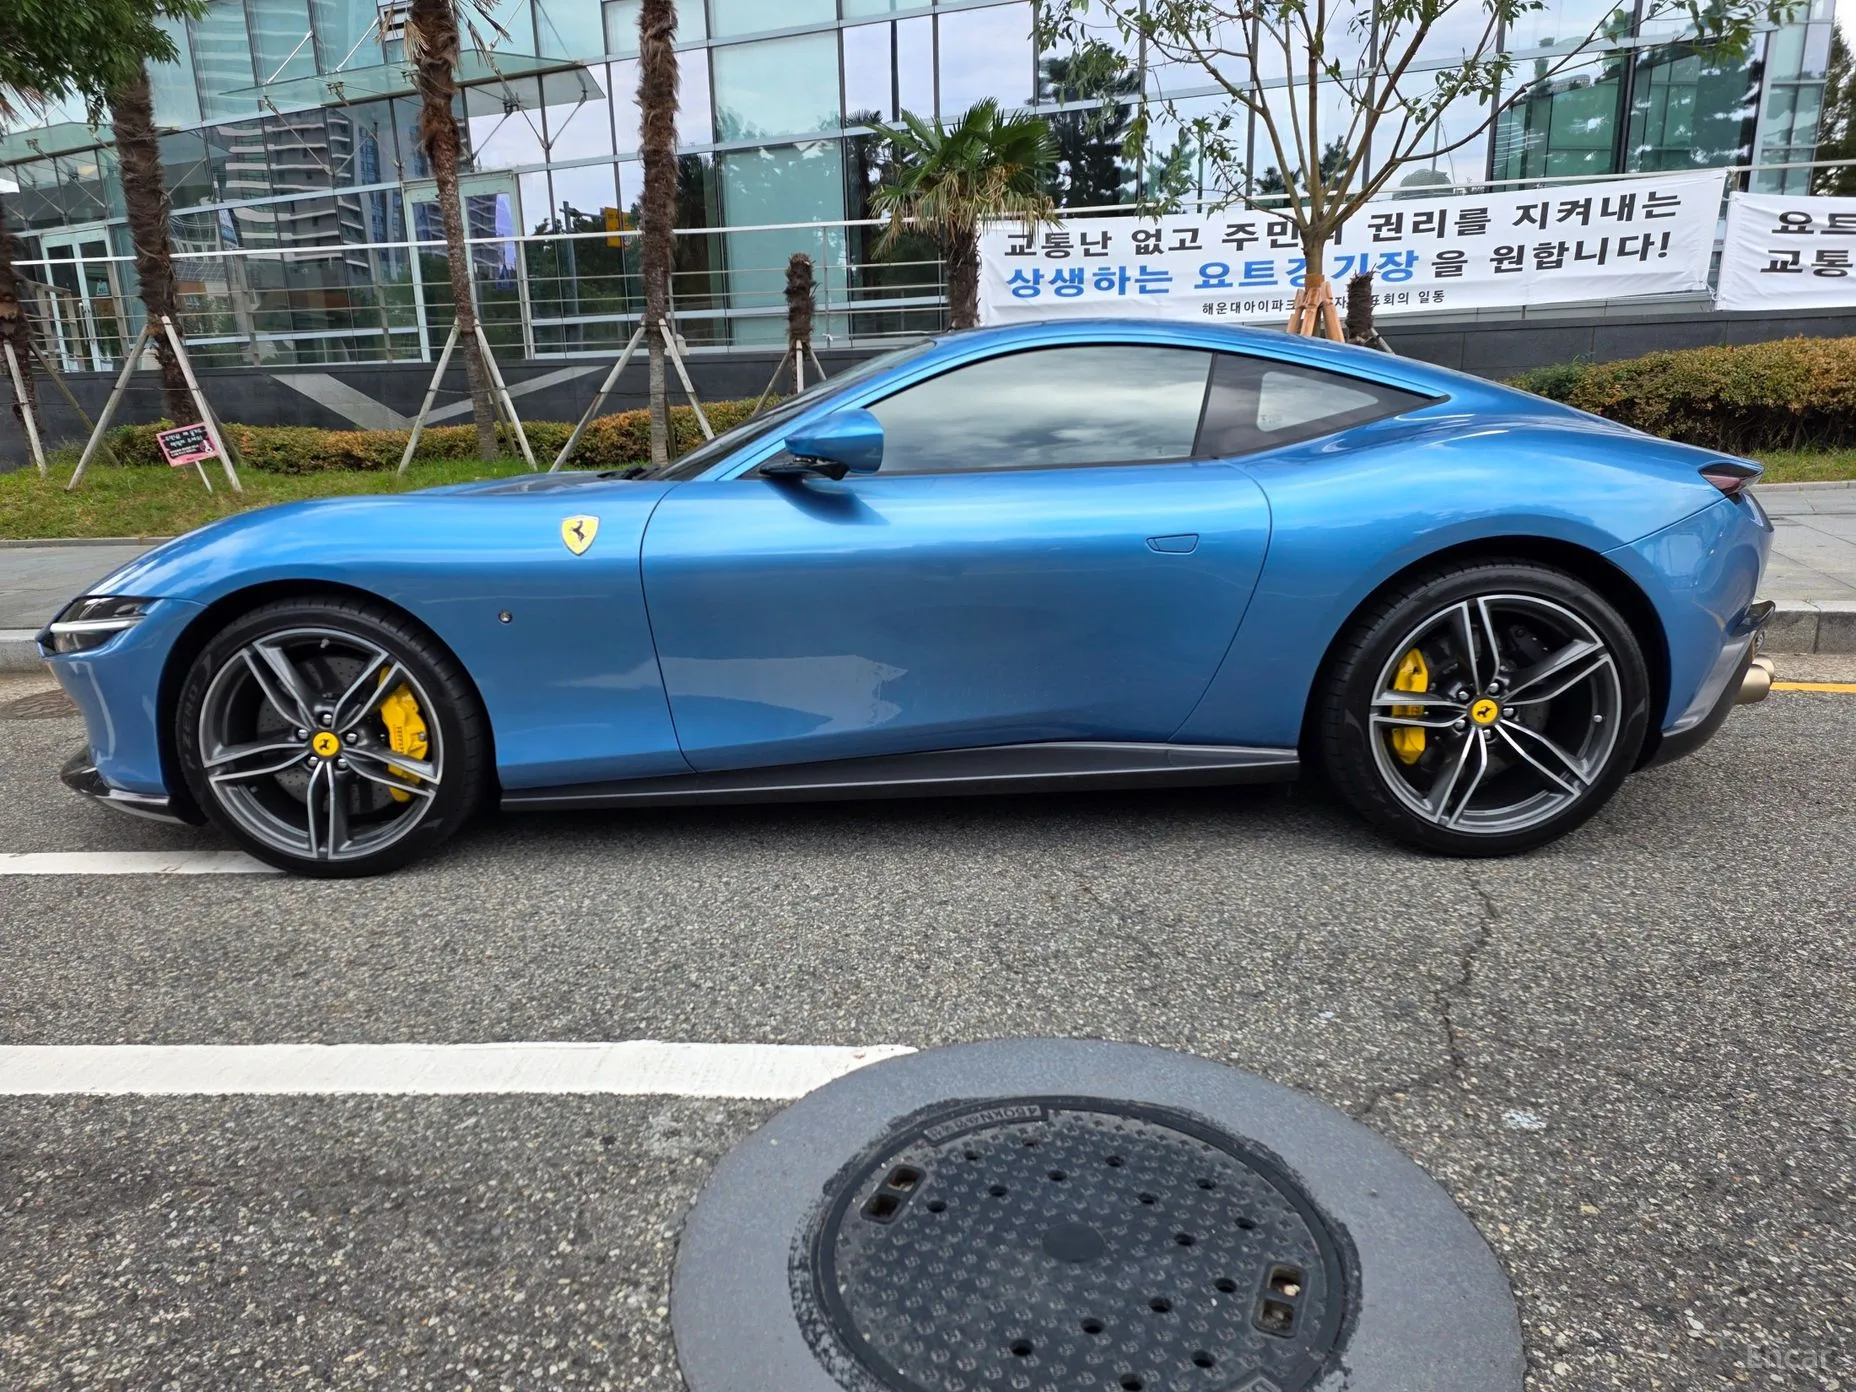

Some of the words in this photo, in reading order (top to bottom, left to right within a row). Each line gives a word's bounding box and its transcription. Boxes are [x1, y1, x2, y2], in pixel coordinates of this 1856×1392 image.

[1004, 230, 1112, 259] 교통난
[1131, 228, 1203, 256] 없고
[1368, 207, 1491, 242] 권리를
[1513, 190, 1682, 230] 지켜내는
[1006, 265, 1173, 298] 상생하는
[1489, 231, 1671, 274] 원합니다!
[1760, 249, 1853, 277] 교통
[1202, 299, 1297, 315] 해운대아이파크
[1418, 289, 1445, 304] 일동
